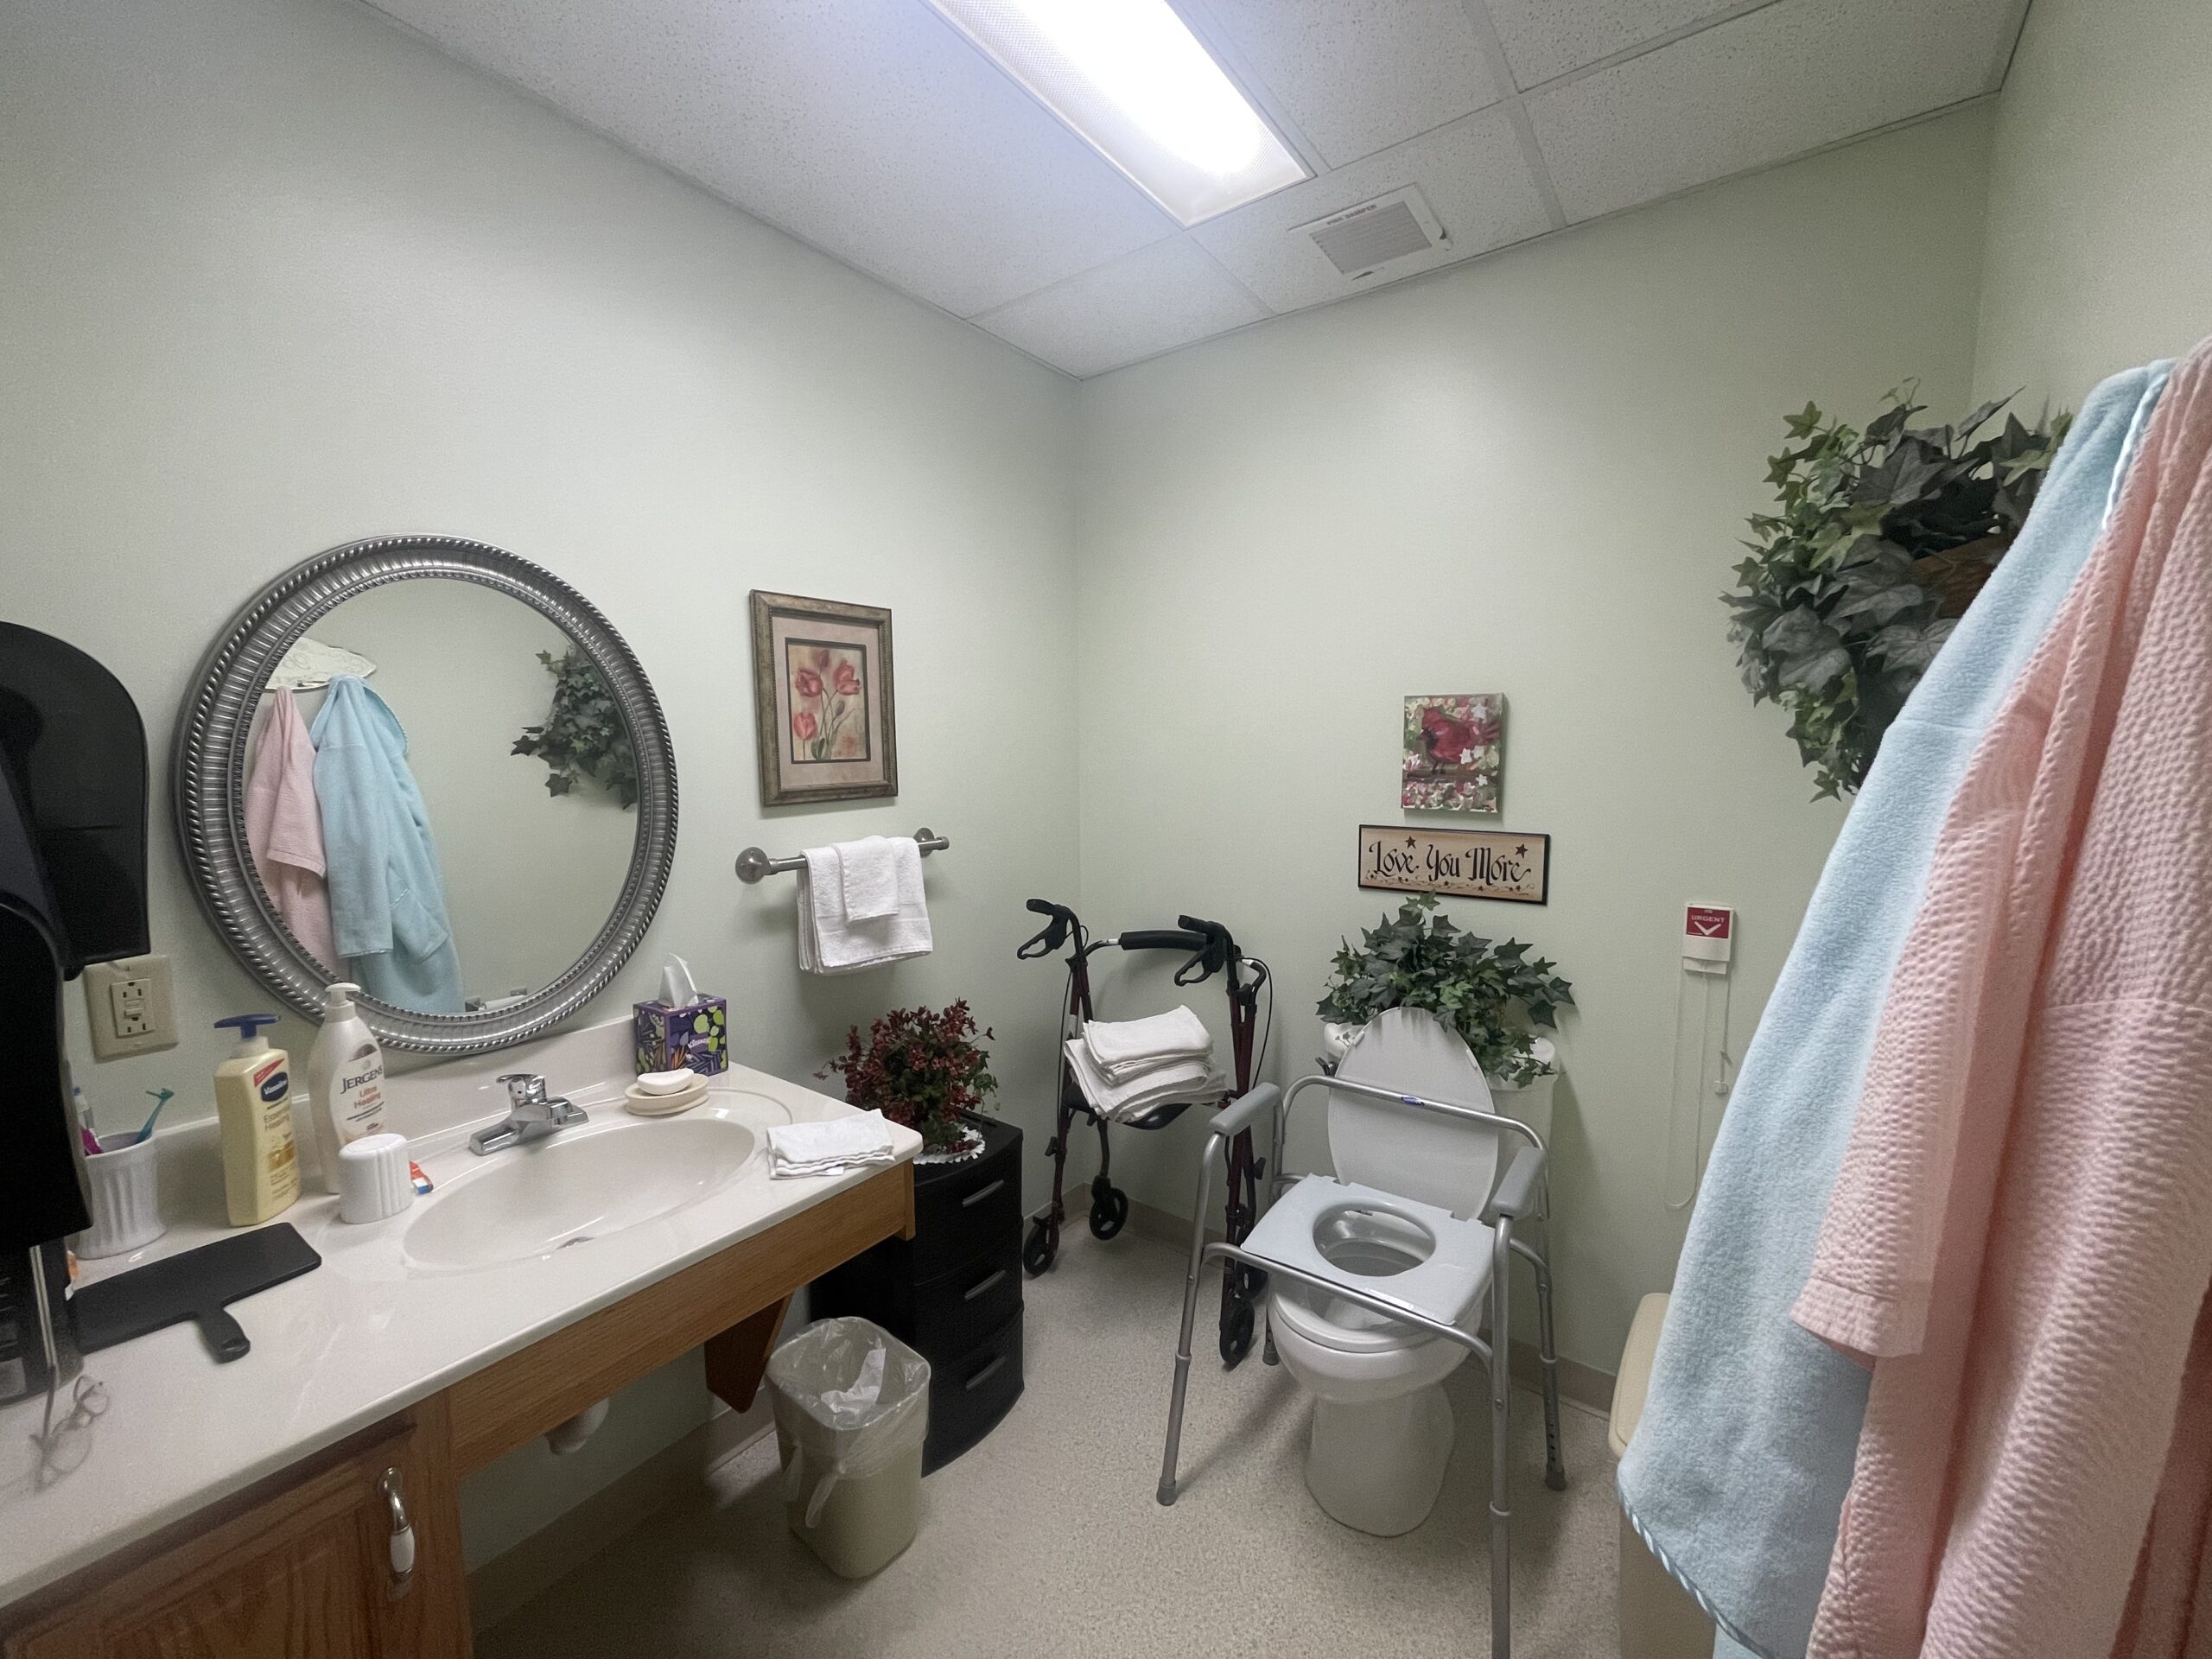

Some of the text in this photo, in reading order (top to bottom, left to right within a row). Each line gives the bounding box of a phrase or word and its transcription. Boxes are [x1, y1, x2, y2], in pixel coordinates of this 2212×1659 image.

[1369, 840, 1531, 887] Love You More
[340, 1064, 383, 1095] JERGENS
